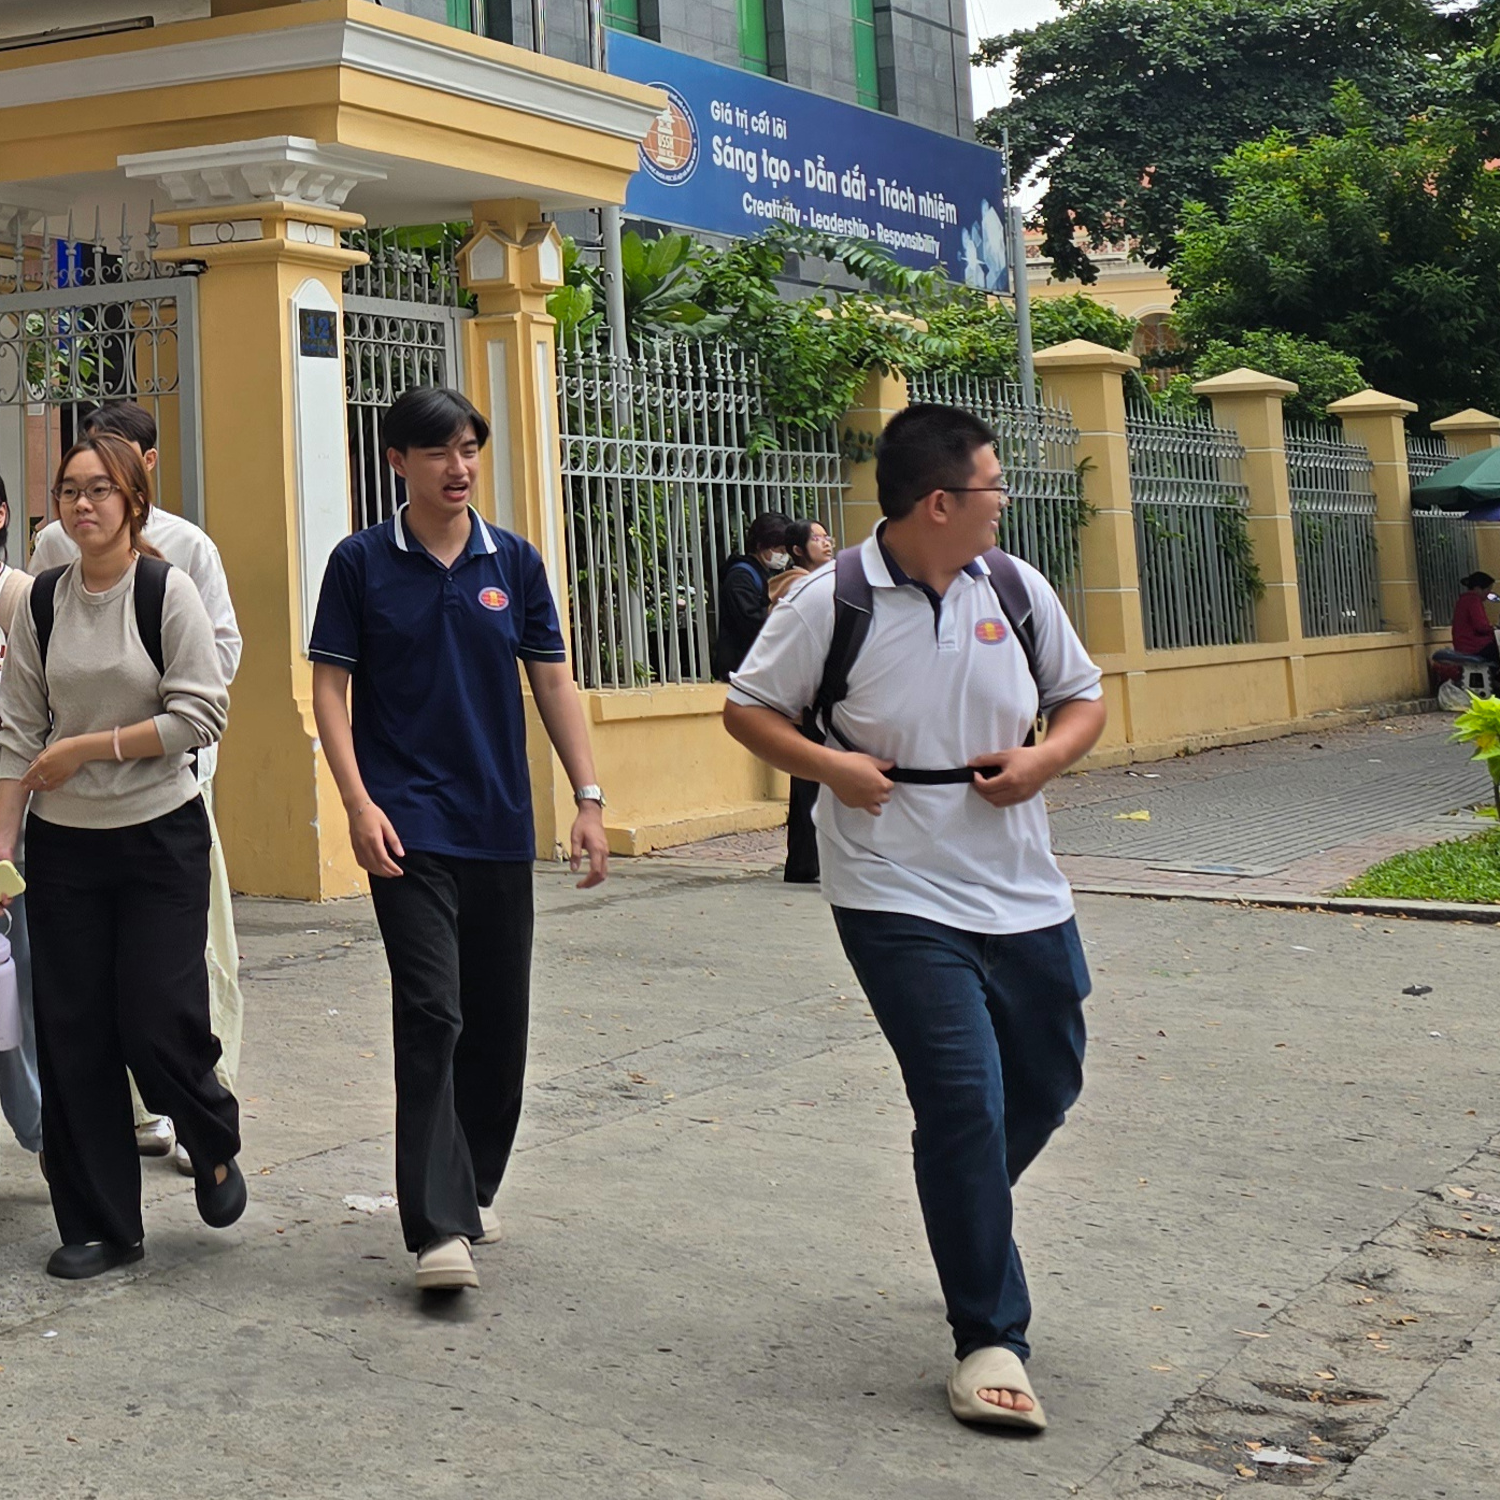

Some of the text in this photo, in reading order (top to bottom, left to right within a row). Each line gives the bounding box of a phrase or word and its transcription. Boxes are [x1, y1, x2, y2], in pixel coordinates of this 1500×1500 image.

[711, 100, 733, 125] Giá
[735, 107, 749, 136] trị
[751, 110, 770, 135] cốt
[772, 114, 788, 140] lõi
[712, 135, 757, 183] Sáng
[761, 148, 791, 188] tạo
[803, 154, 837, 194] Dẫn
[841, 164, 867, 201] dắt
[877, 177, 916, 214] Trách
[918, 191, 958, 230] nhiệm
[809, 207, 869, 239] Leadership
[876, 222, 940, 259] Responsibility
